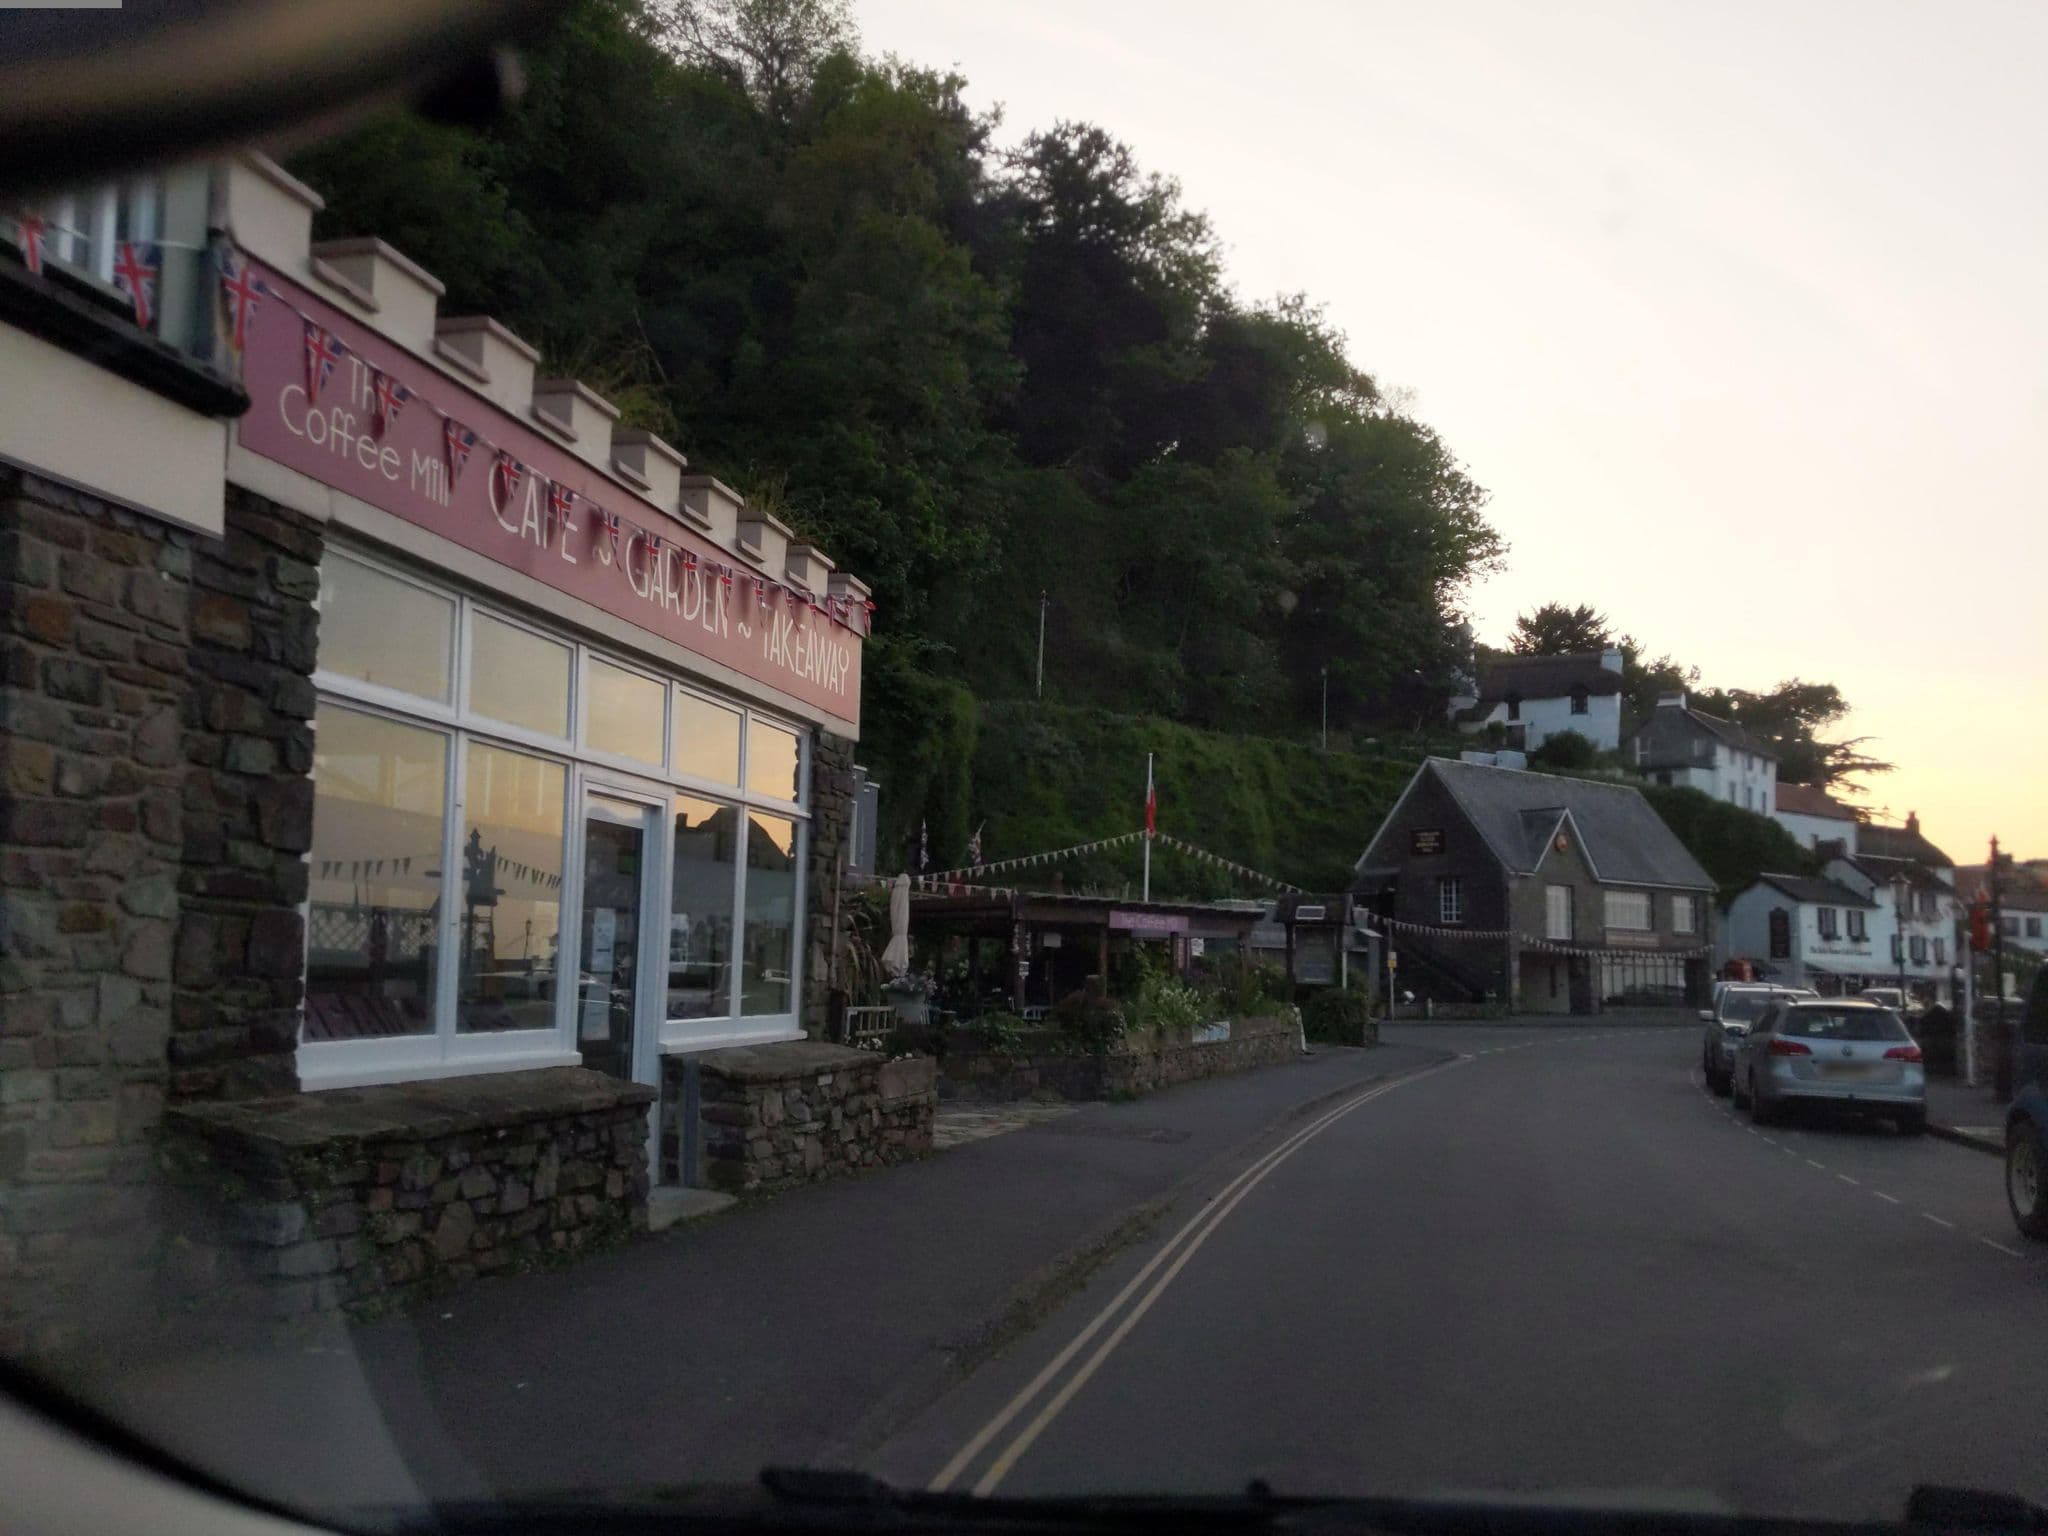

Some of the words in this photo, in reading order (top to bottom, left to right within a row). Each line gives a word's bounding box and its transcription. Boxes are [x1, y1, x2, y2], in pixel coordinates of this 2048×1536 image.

[348, 355, 379, 415] Th
[280, 384, 401, 480] Coffee
[411, 448, 449, 507] Mill
